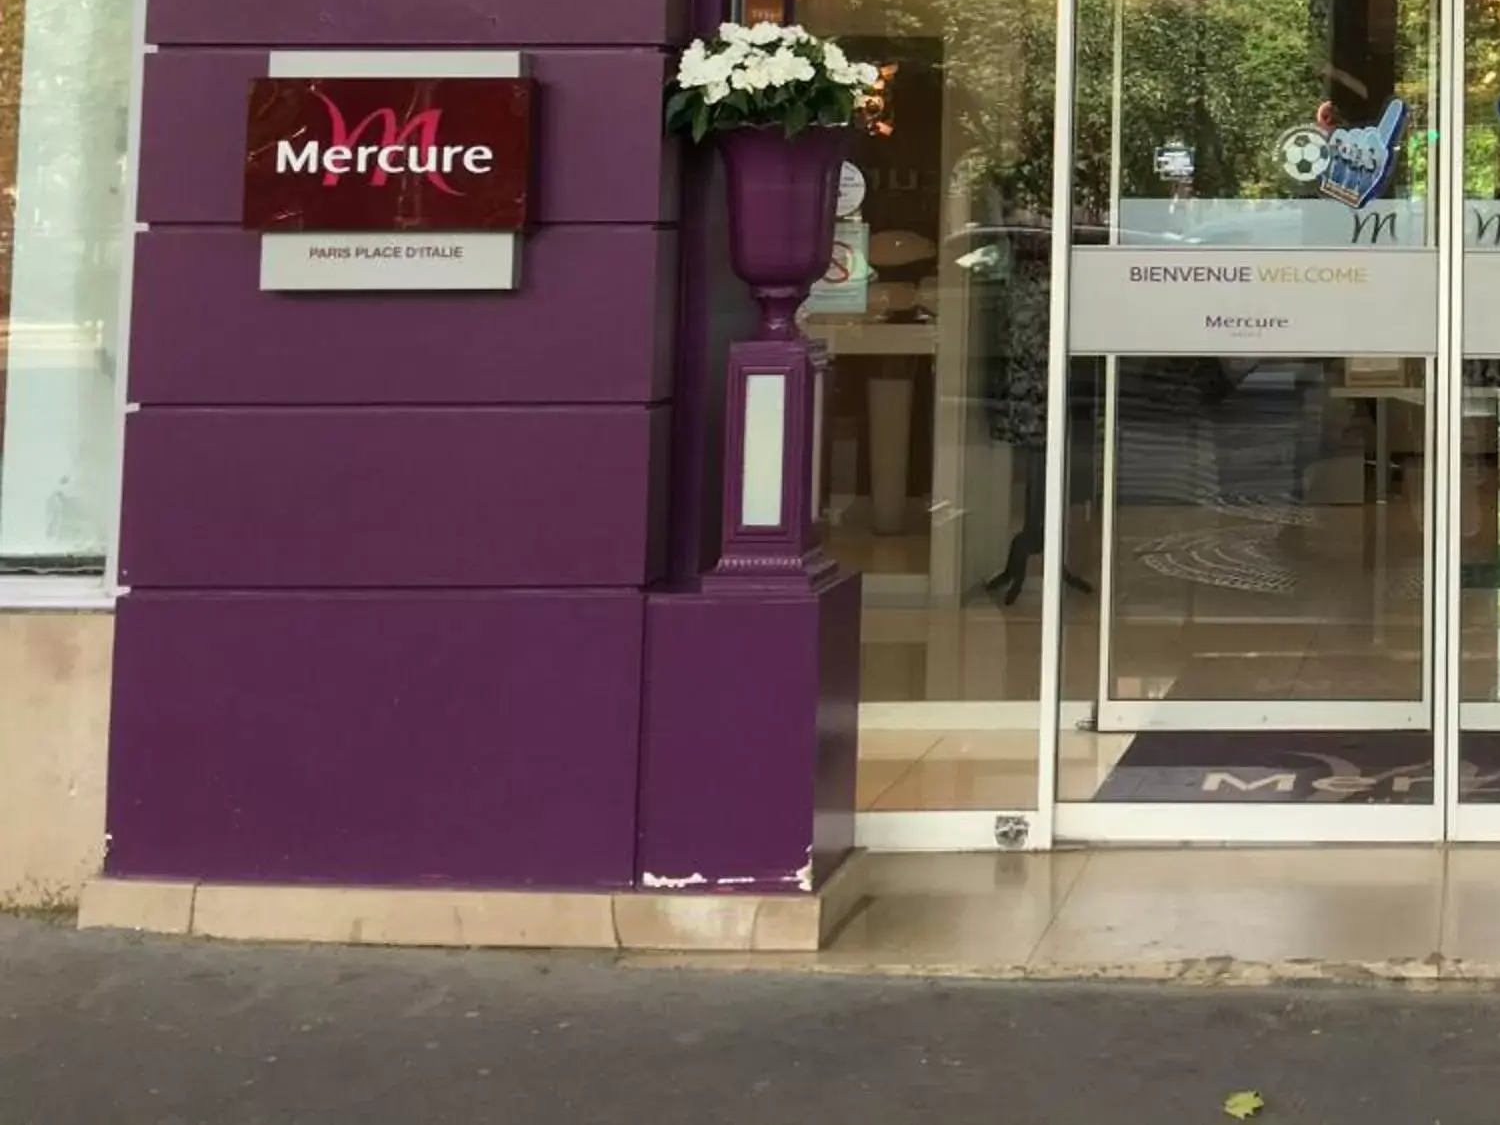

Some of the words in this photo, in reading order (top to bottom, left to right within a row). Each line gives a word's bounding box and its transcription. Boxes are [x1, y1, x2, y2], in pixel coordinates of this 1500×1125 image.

[276, 140, 493, 175] Mercure
[309, 246, 351, 259] PARIS
[355, 246, 403, 259] PLACE
[405, 246, 464, 259] D'ITALIE
[1129, 266, 1252, 283] BIENVENUE
[1257, 266, 1369, 284] WELCOME
[1204, 315, 1290, 329] Mercure
